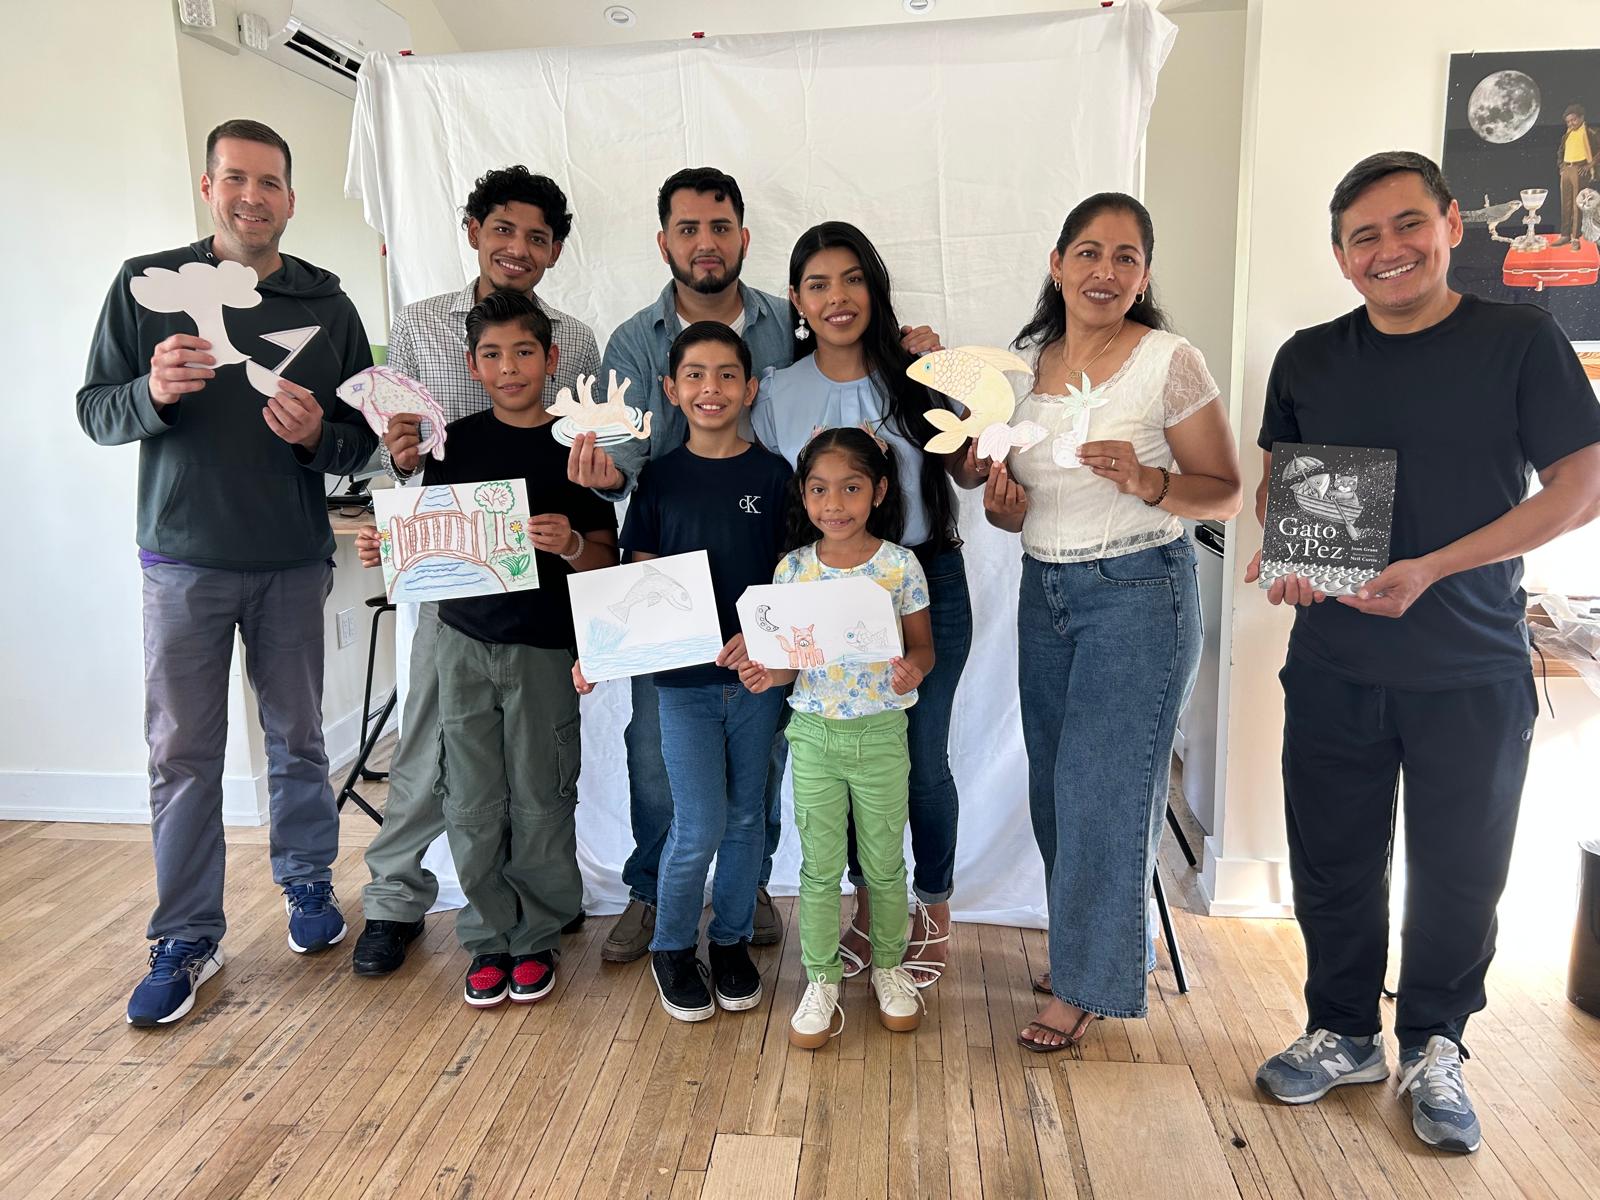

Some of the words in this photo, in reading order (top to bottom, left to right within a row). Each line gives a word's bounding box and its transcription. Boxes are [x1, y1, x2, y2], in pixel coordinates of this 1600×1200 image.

[1279, 517, 1336, 538] Gato
[1284, 542, 1299, 561] y
[1303, 539, 1343, 559] Pez
